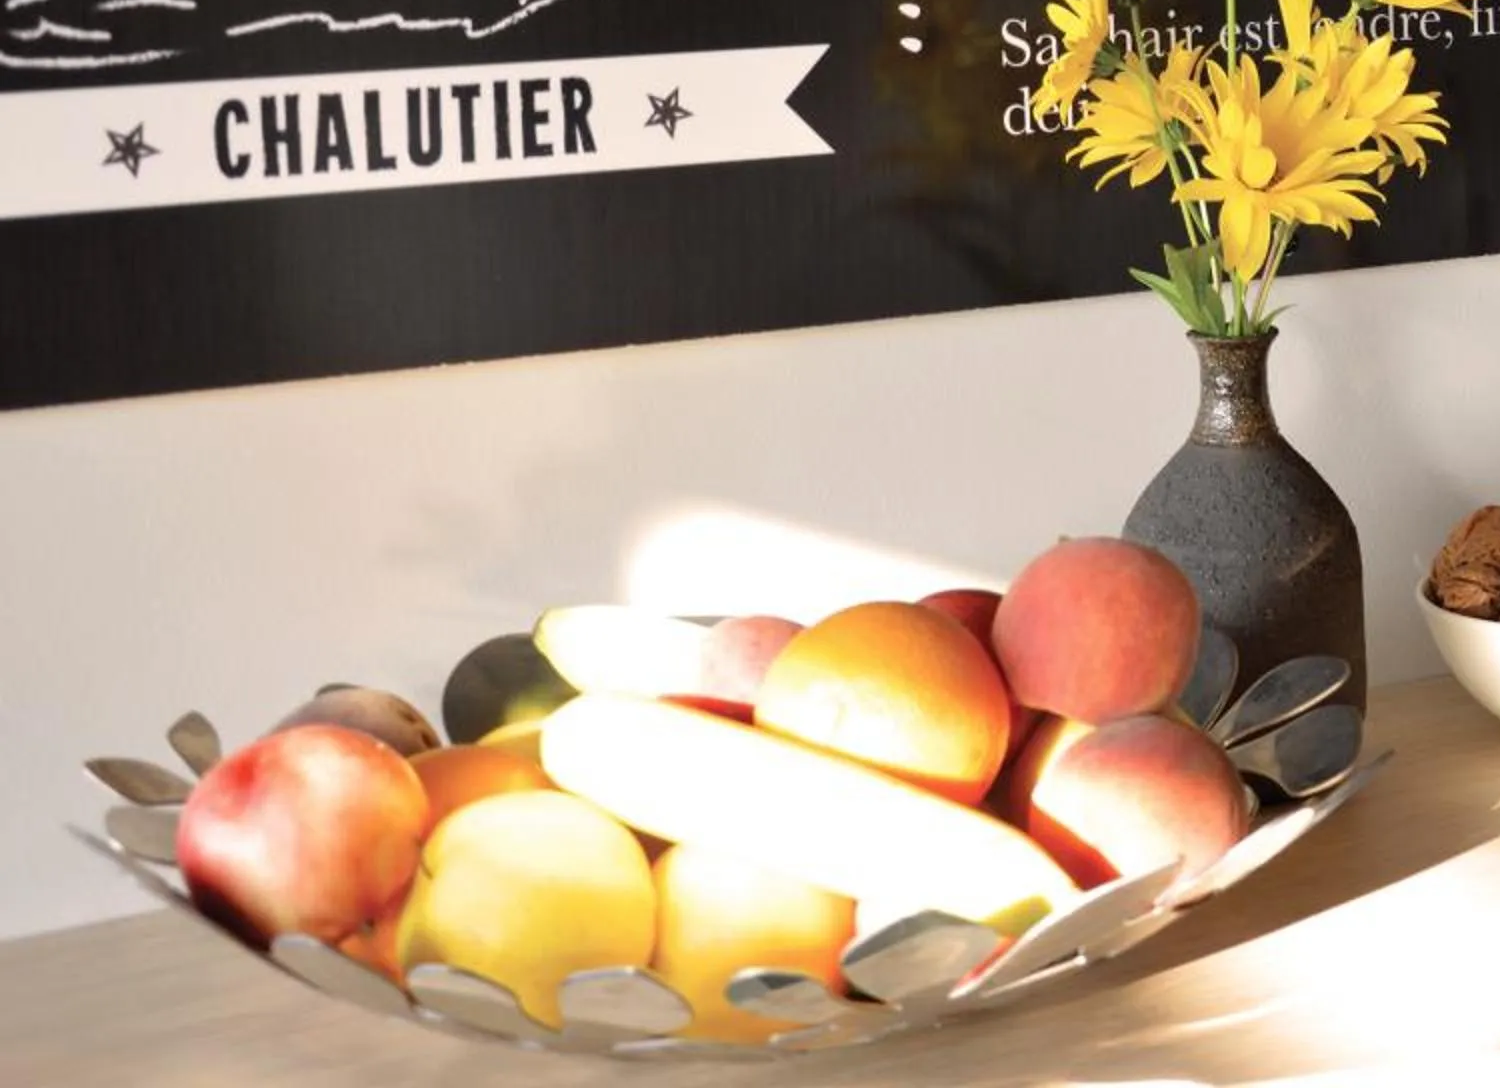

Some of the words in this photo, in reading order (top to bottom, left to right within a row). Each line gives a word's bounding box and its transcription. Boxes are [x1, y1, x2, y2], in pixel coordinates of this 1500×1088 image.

[1002, 19, 1059, 68] Sa
[1107, 9, 1203, 57] hair
[1219, 15, 1281, 53] est
[215, 78, 595, 178] CHALUTIER
